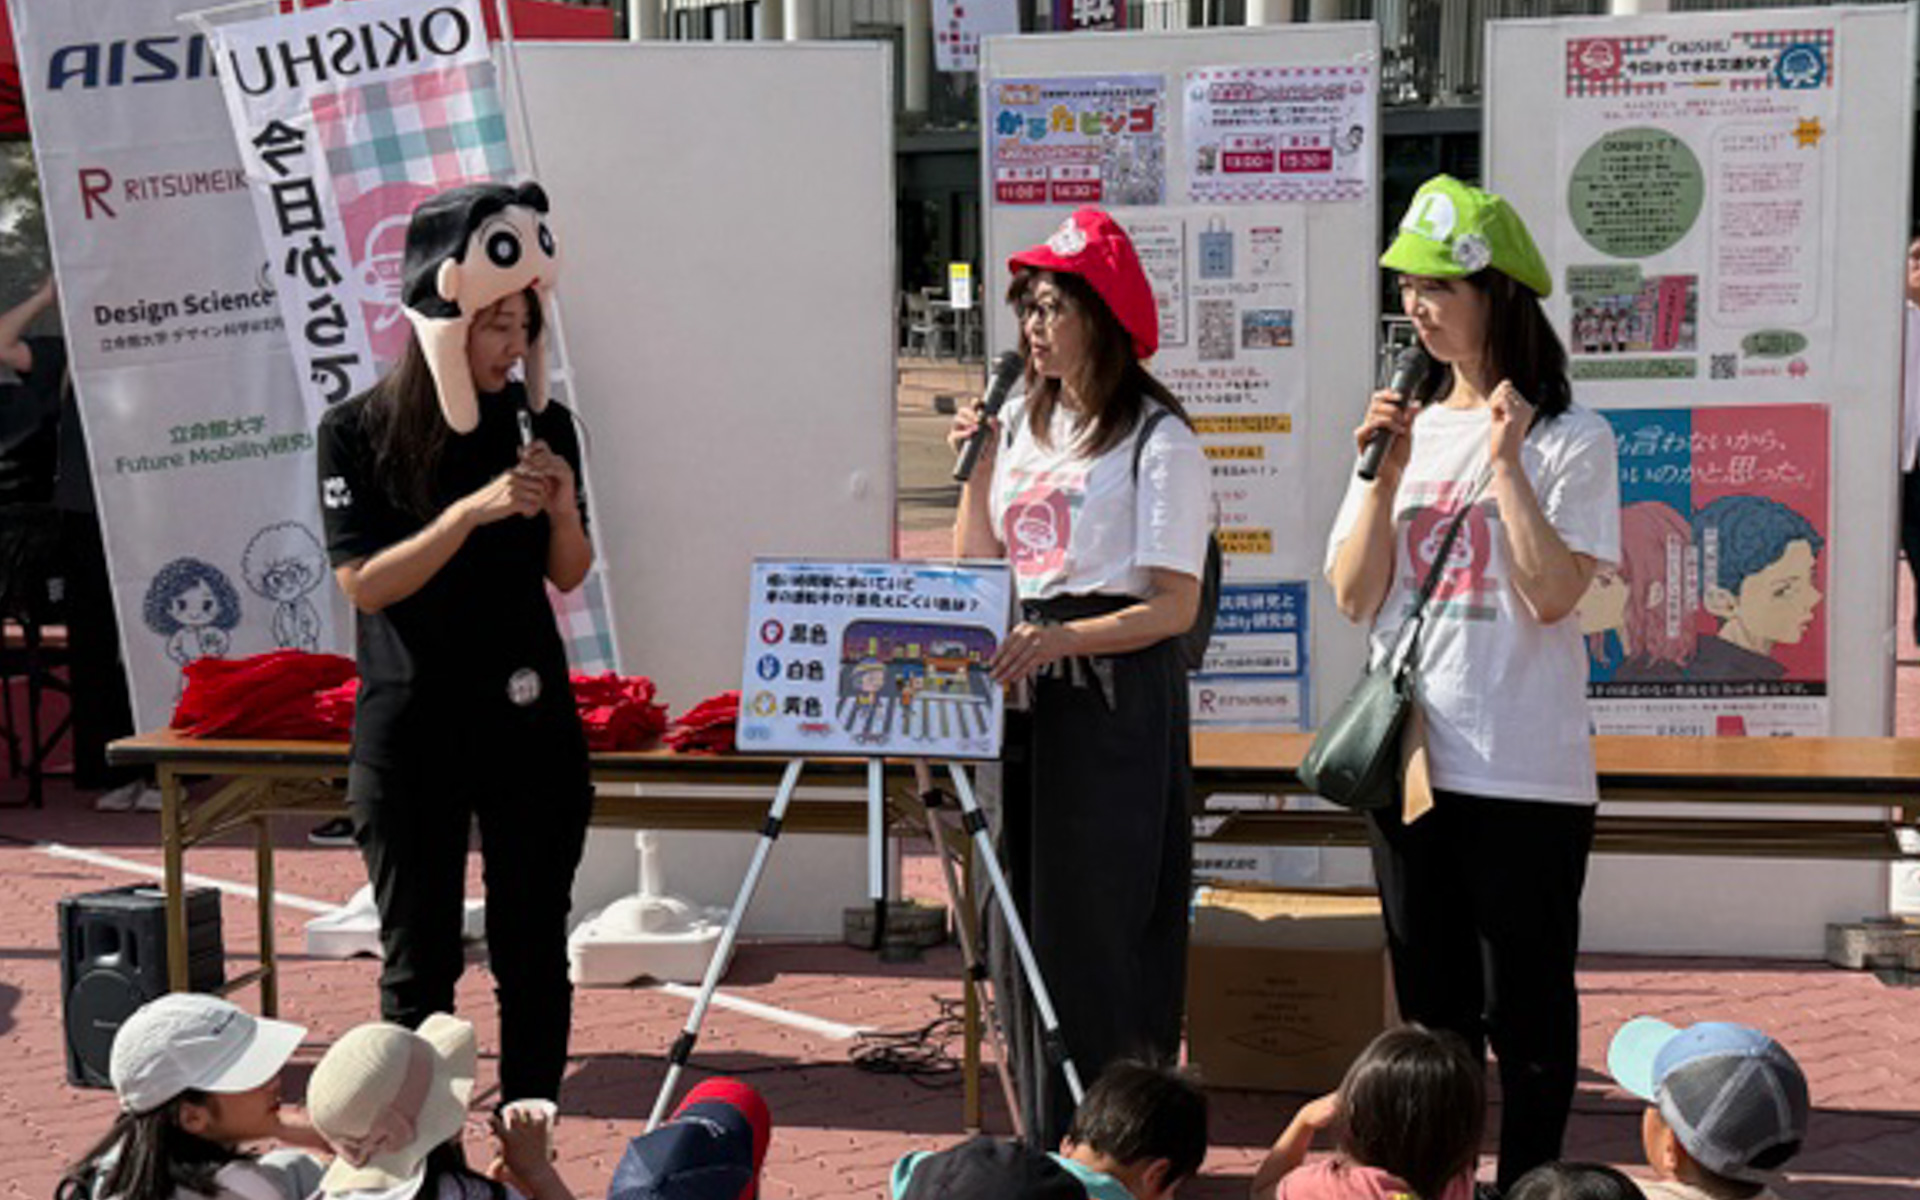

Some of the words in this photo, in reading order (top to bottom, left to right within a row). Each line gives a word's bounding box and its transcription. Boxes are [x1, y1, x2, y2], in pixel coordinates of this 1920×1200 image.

[47, 33, 219, 90] AISI
[94, 299, 179, 327] Design
[182, 289, 277, 315] Science
[114, 452, 185, 474] Future
[789, 623, 828, 645] 黒色
[785, 661, 825, 682] 白色
[782, 696, 822, 718] 黄色
